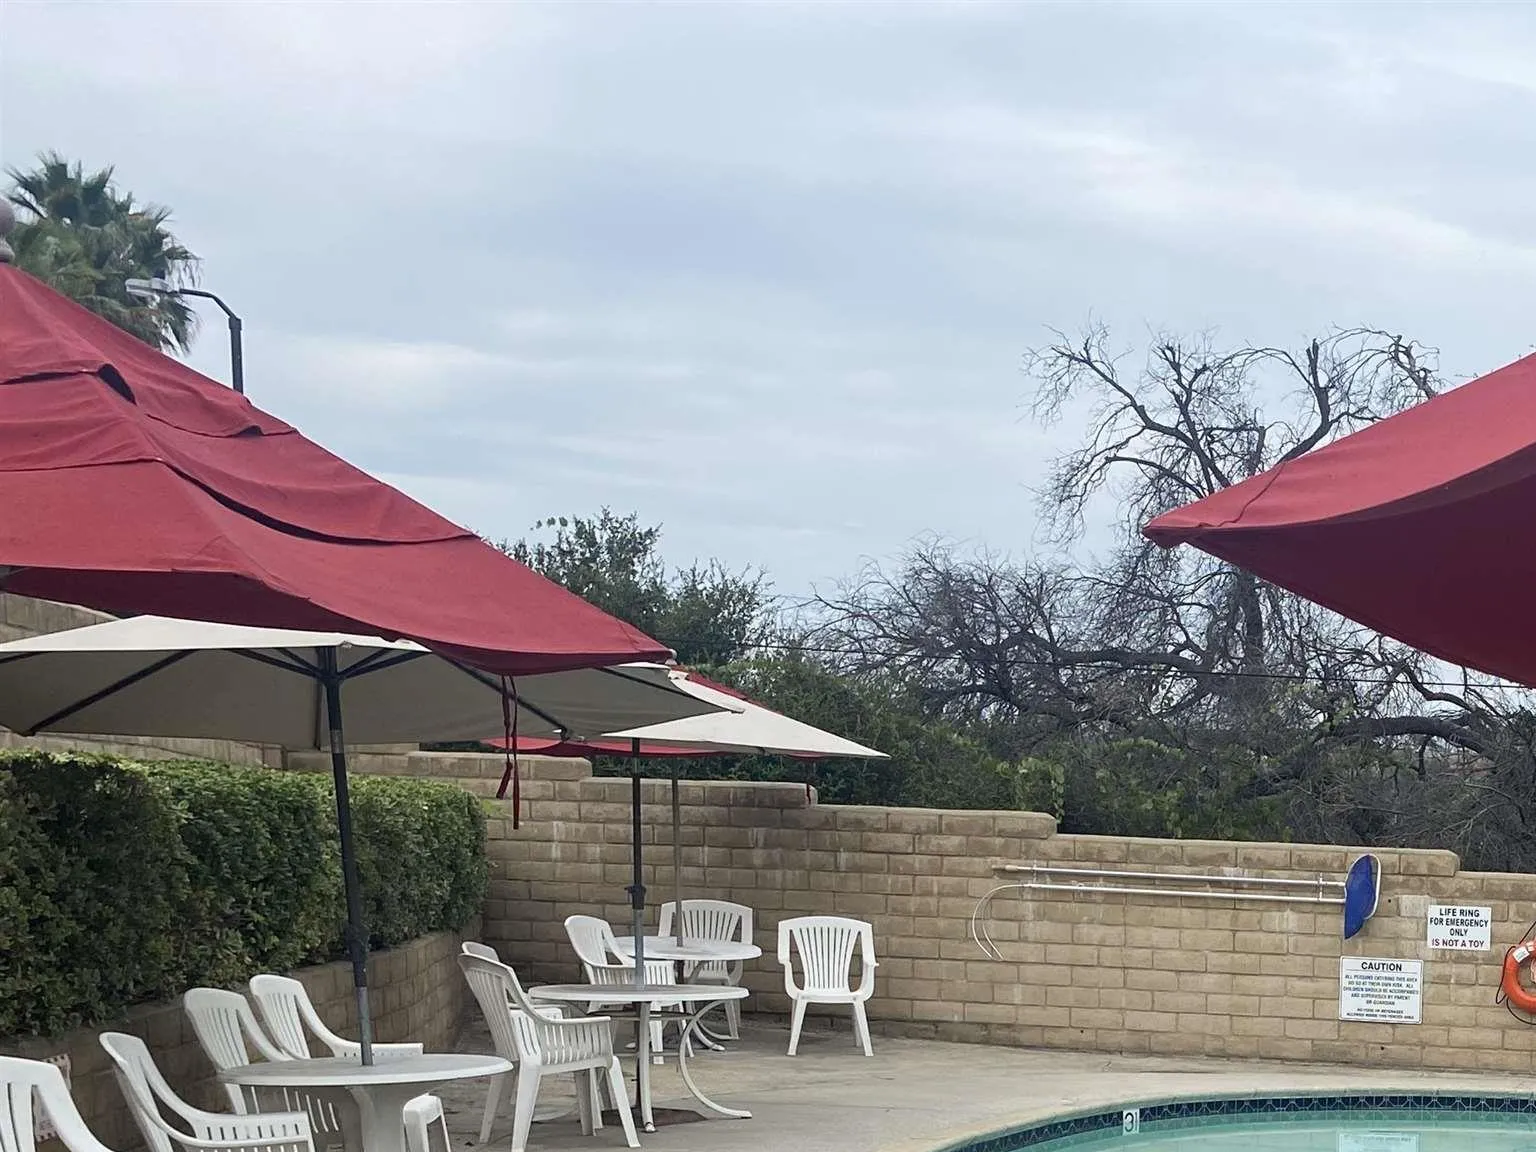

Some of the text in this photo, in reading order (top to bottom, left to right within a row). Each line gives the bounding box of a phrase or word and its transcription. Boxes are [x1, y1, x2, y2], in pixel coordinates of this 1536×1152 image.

[1440, 908, 1480, 917] LIFE RING
[1446, 918, 1488, 927] EMERGENCY
[1450, 928, 1468, 936] ONLY
[1432, 938, 1439, 946] IS
[1469, 940, 1484, 948] TOY
[1361, 962, 1402, 971] CAUTION
